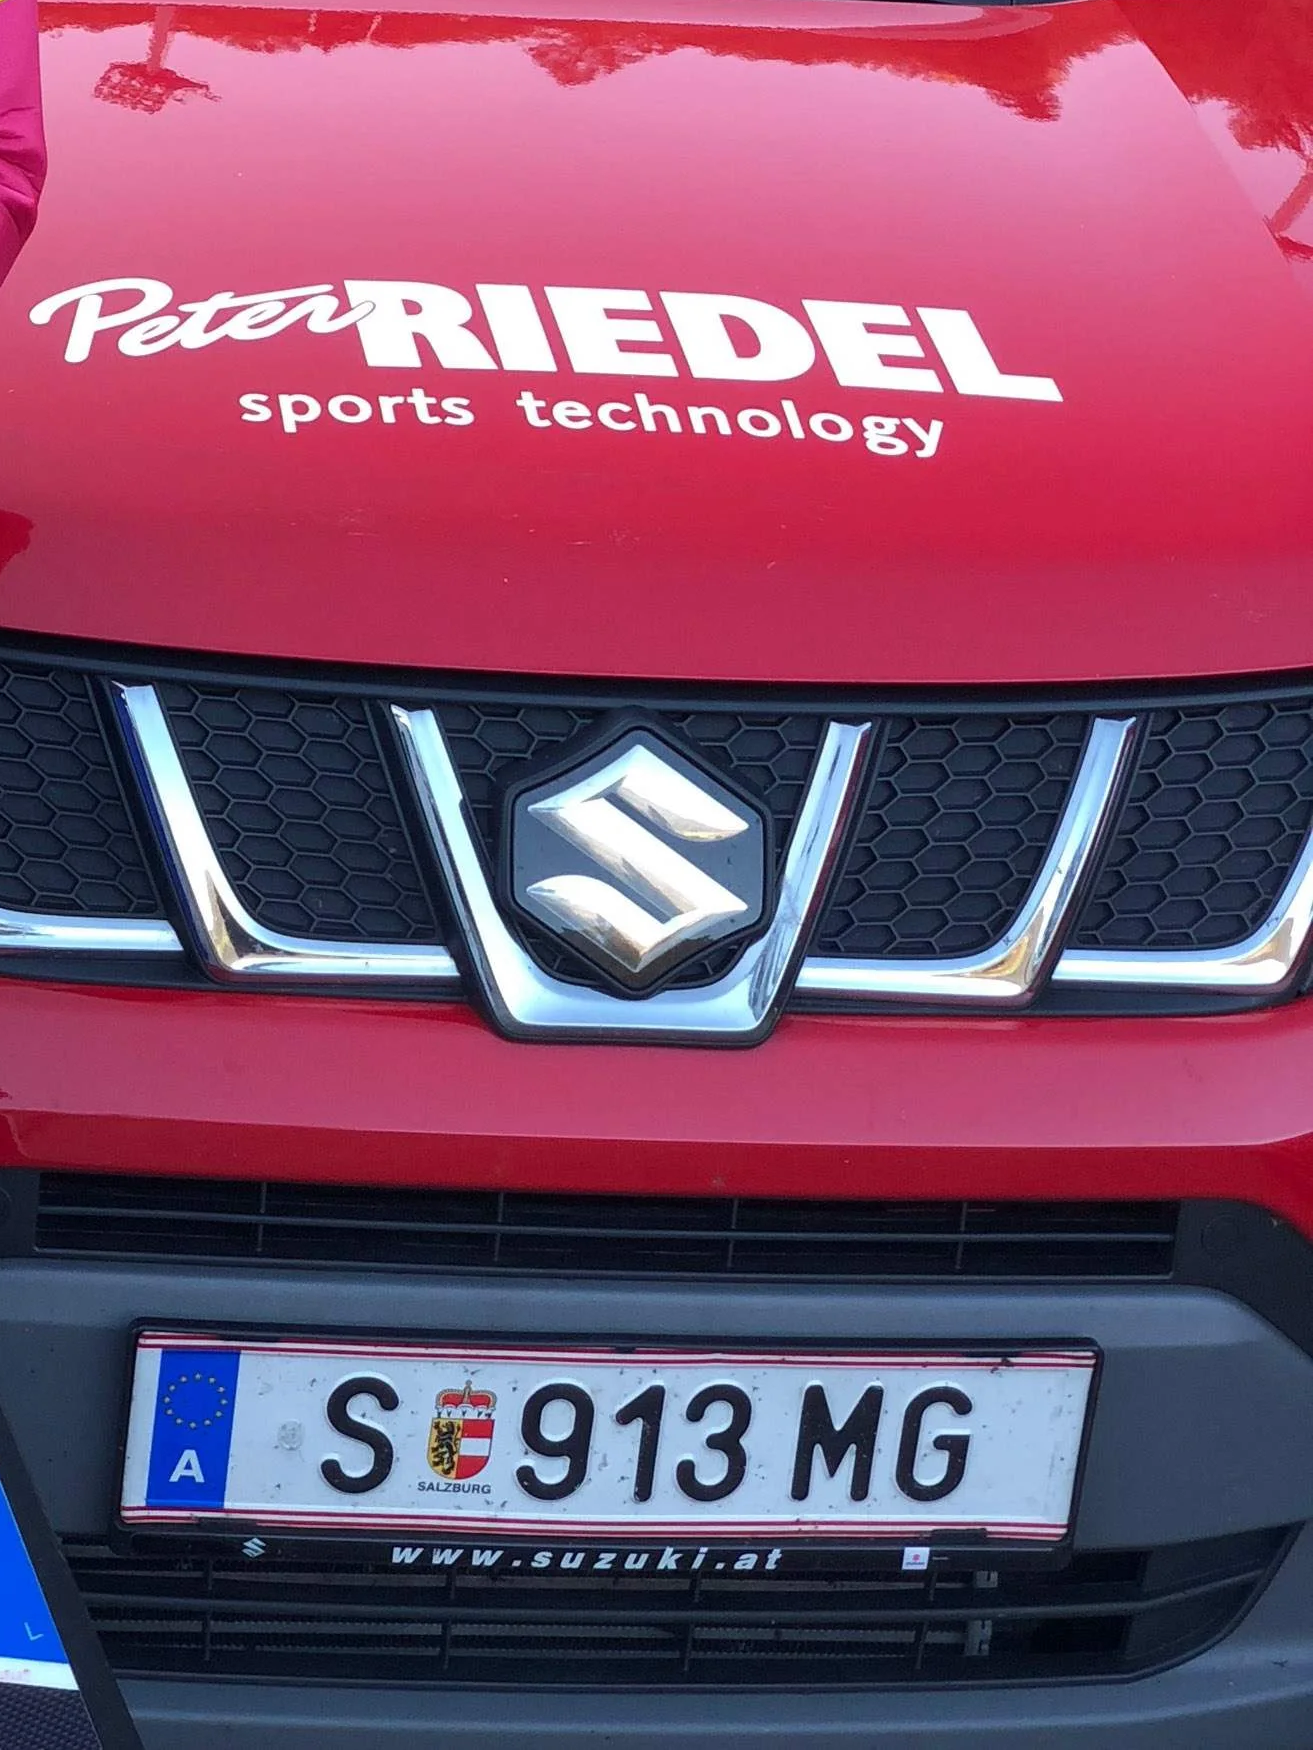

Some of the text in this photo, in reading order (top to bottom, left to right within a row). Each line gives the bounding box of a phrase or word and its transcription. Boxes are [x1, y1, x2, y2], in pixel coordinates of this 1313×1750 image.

[28, 276, 1065, 403] Peter RIEDEL
[238, 386, 945, 459] sports technology
[320, 1371, 976, 1504] S 913 MG
[168, 1448, 207, 1484] A
[417, 1481, 492, 1495] SALZBURG
[390, 1543, 785, 1573] www.suzuki.at
